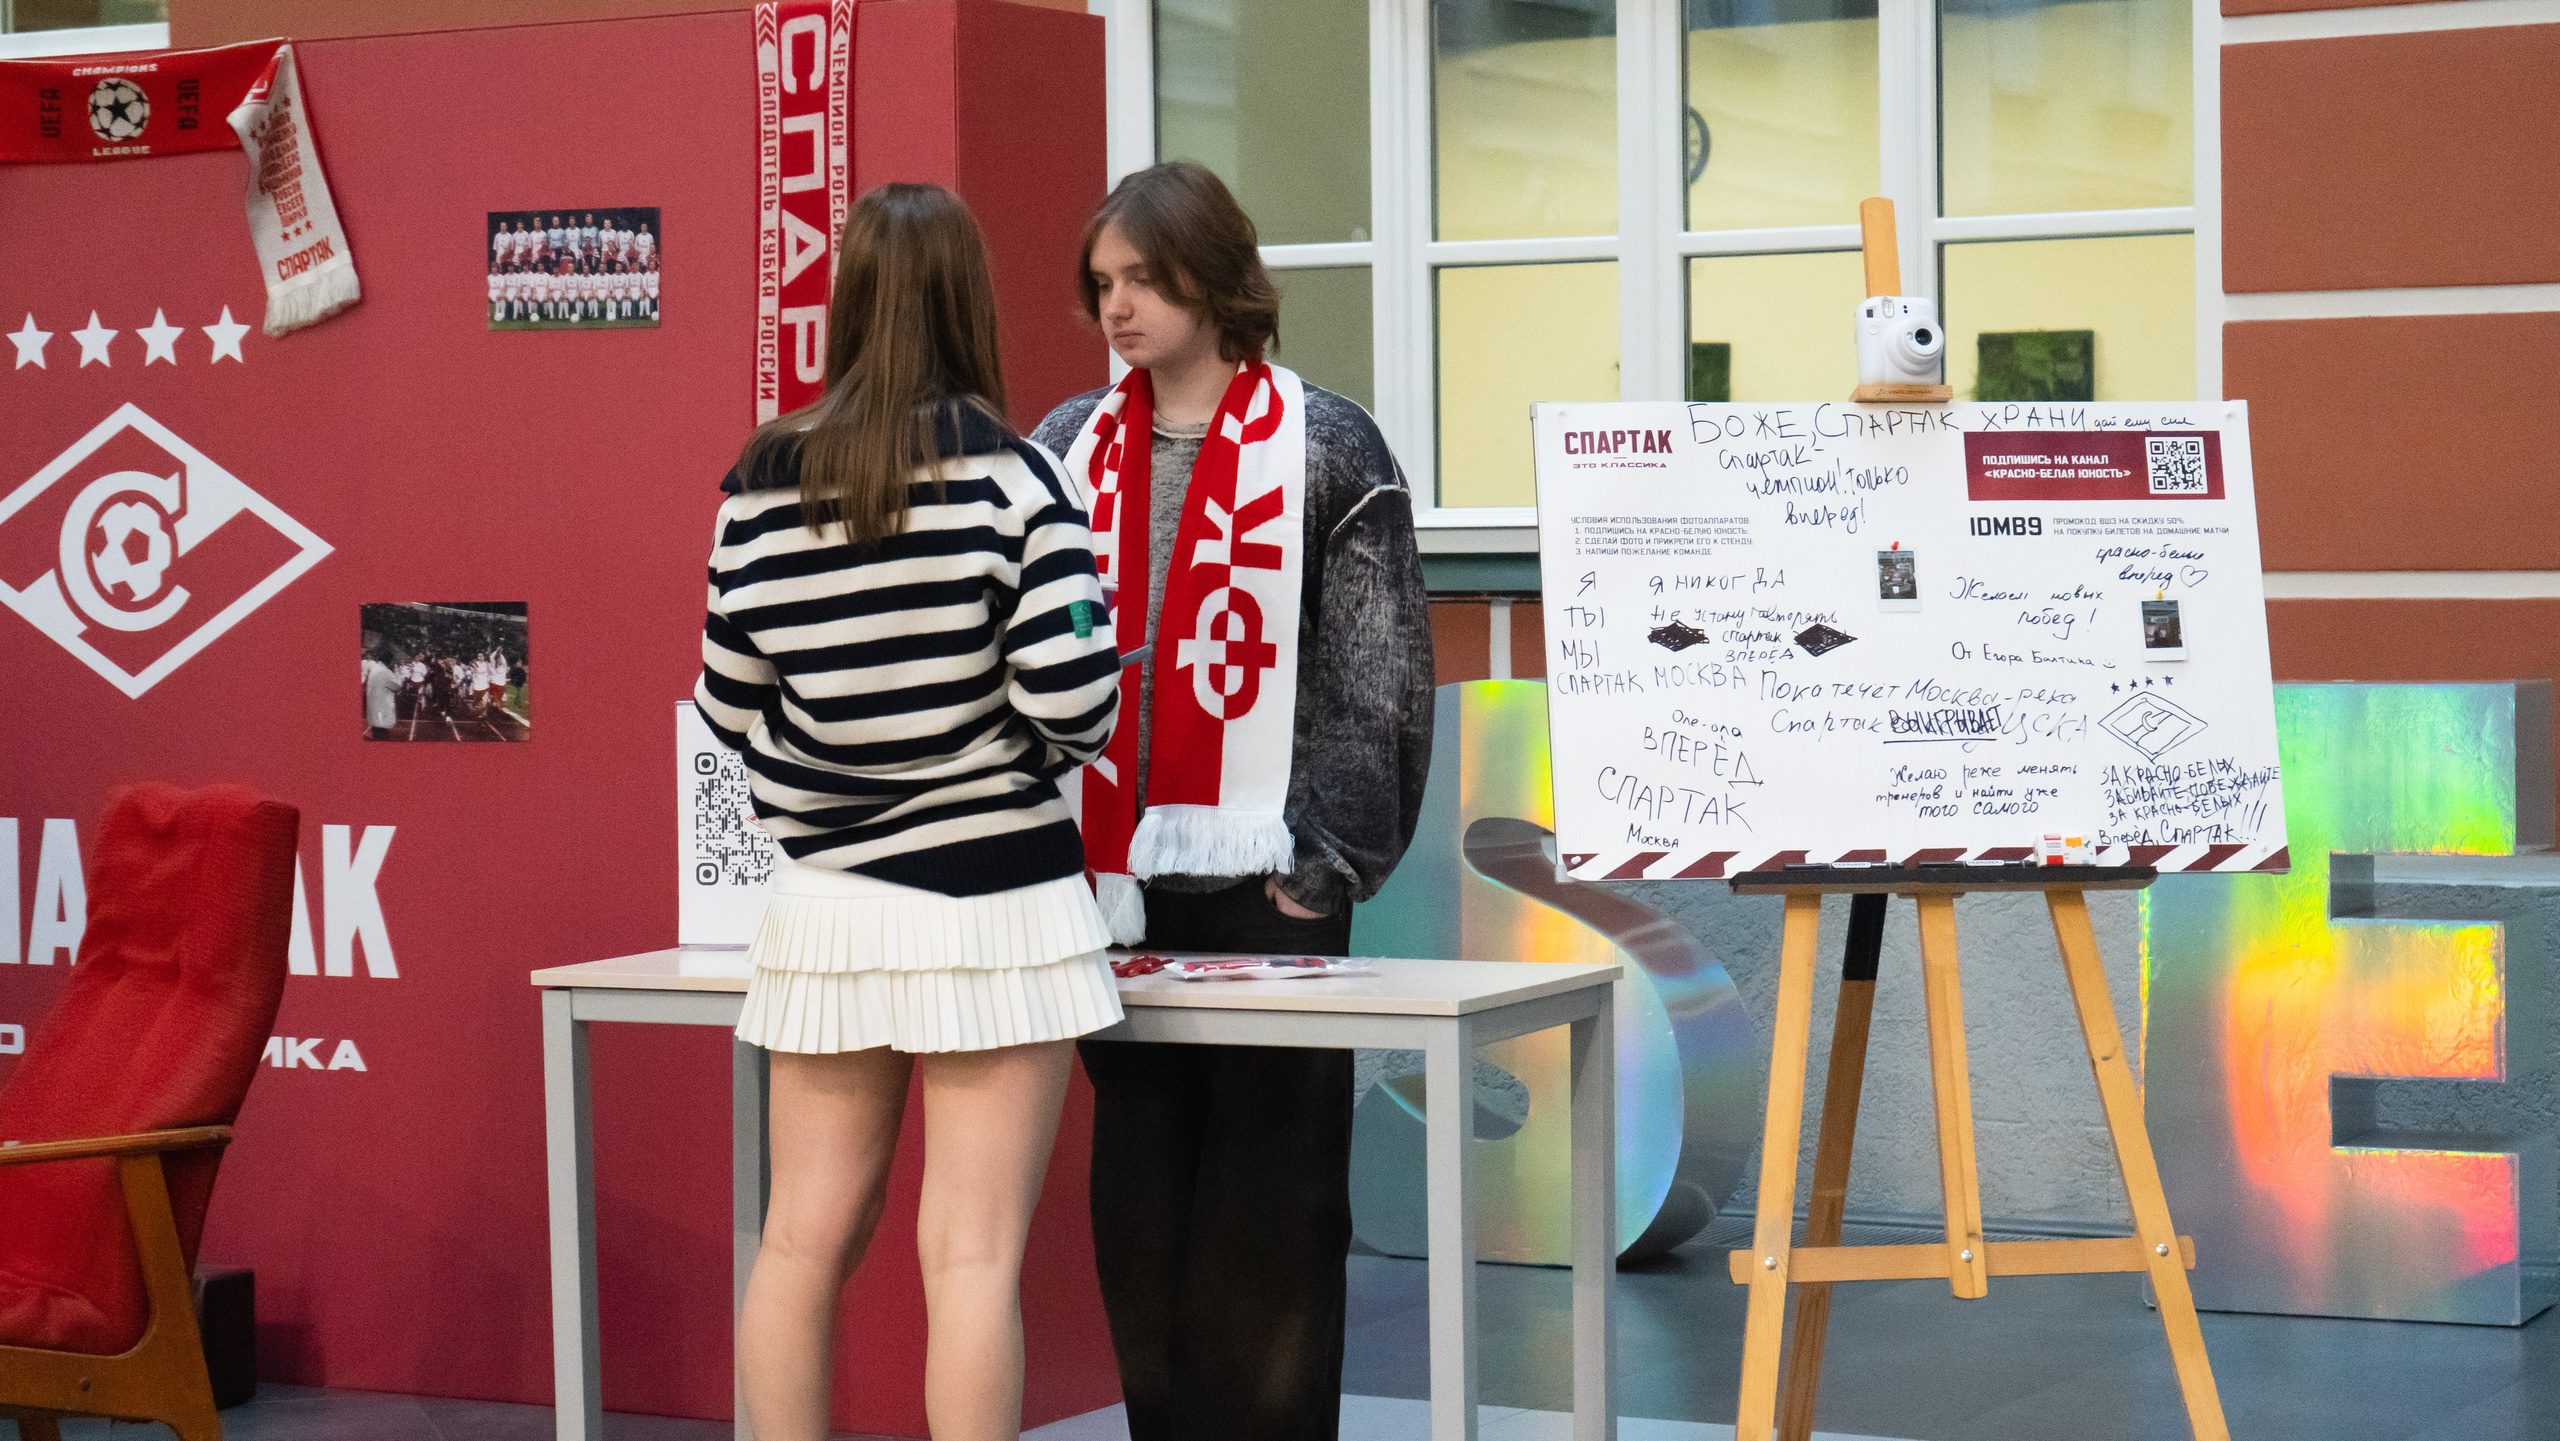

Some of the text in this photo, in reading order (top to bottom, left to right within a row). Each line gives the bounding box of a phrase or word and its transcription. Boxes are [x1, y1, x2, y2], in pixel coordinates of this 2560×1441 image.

[72, 63, 159, 77] CHAMPIONS
[831, 43, 847, 147] ЧЕМПИОН
[92, 145, 151, 157] LEAGUE
[759, 71, 777, 401] ОБЛАДАТЕЛЬ КУБКА РОССИИ
[276, 236, 335, 281] СПАРТАК
[1980, 404, 2086, 431] ХРАНИ
[1564, 429, 1673, 455] СПАРТАК
[1572, 461, 1668, 469] ЭТО КЛАССИКА
[1982, 454, 2109, 467] ПОДПИШИСЬ НА КАНАЛ
[1984, 468, 2132, 480] «КРАСНО-БЕЛАЯ ЮНОСТЬ»
[1570, 516, 1608, 525] УСЛОВИЯ
[1610, 516, 1678, 525] ИСПОЛЬЗОВАНИЯ
[2053, 518, 2097, 526] ПРОМОКОД
[2131, 518, 2165, 526] СКИДКУ
[2166, 517, 2185, 525] 50%
[1584, 527, 1635, 536] ПОДПИШИСЬ
[1636, 527, 1647, 535] НА
[1649, 527, 1712, 536] КРАСНО-БЕЛУЮ
[2067, 528, 2103, 536] ПОКУПКУ
[2203, 527, 2230, 535] МАТЧИ
[1585, 537, 1618, 546] СДЕЛАЙ
[1620, 537, 1643, 545] ФОТО
[1645, 537, 1651, 545] И
[1653, 538, 1694, 546] ПРИКРЕПИ
[1585, 548, 1619, 556] НАПИШИ
[1621, 548, 1671, 556] ПОЖЕЛАНИЕ
[1673, 548, 1712, 556] КОМАНДЕ
[1577, 571, 1597, 598] Я
[2050, 582, 2105, 602] новых
[1561, 639, 1601, 670] МЫ
[1951, 641, 1972, 660] От
[1983, 643, 2024, 666] Егора
[1557, 662, 1748, 697] СПАРТАК МОСКВА
[1761, 669, 1823, 702] Пока
[2017, 763, 2078, 776] менять
[1597, 765, 1754, 833] СПАРТАК
[1972, 784, 2014, 798] найти
[2024, 787, 2059, 802] уже
[1972, 801, 2039, 816] самого
